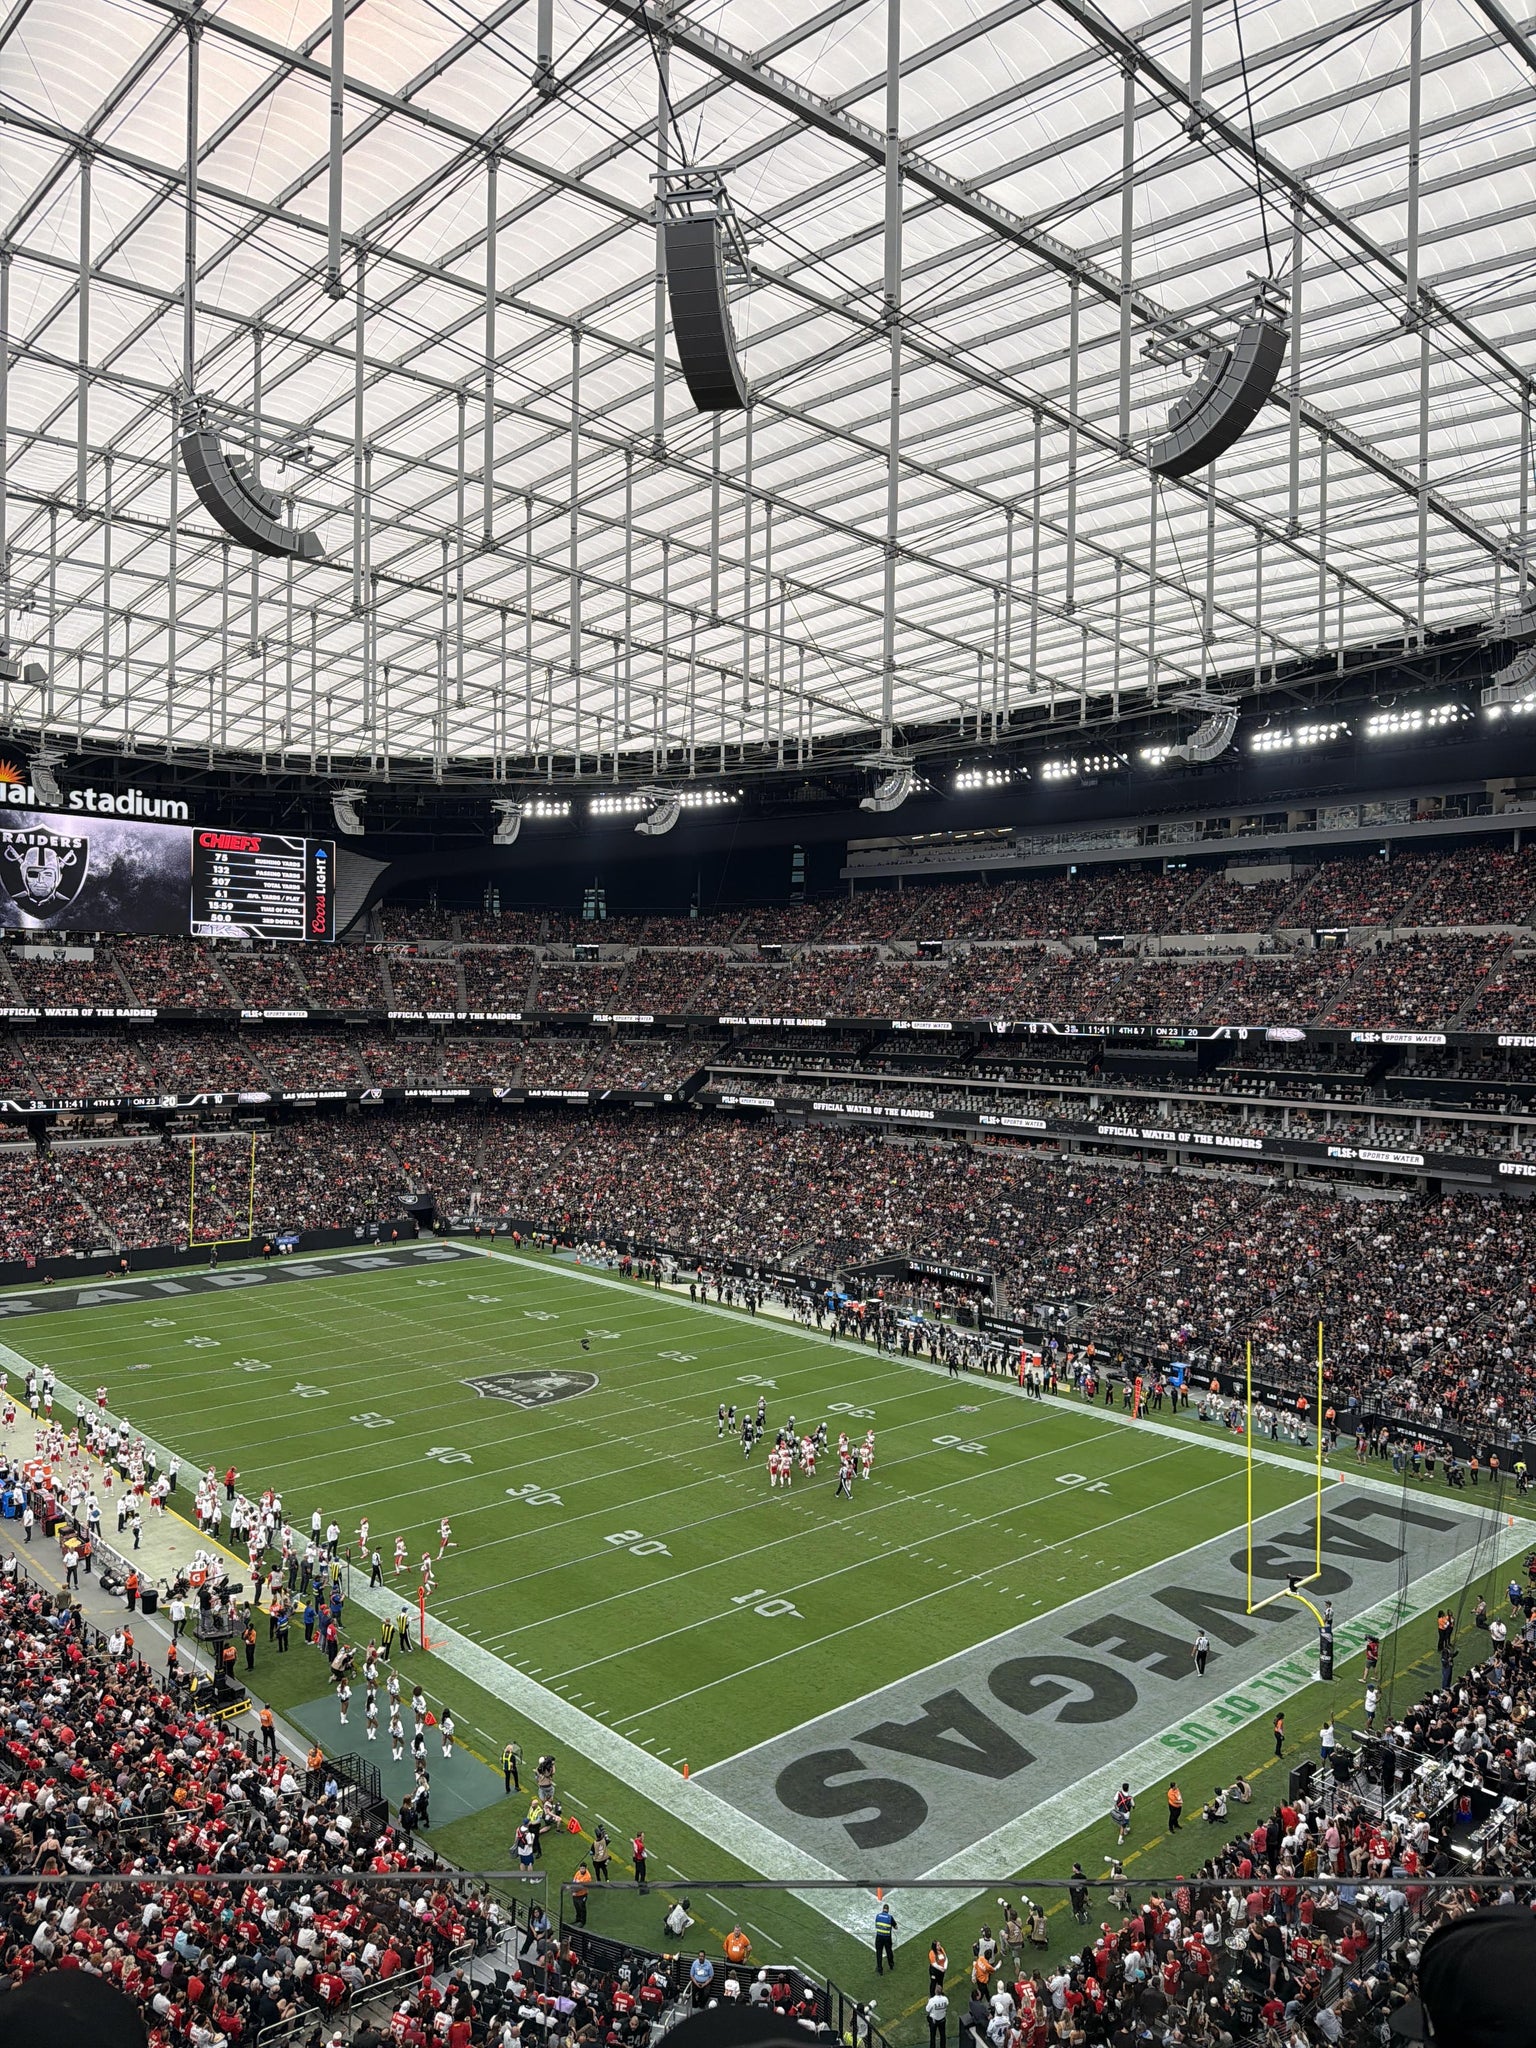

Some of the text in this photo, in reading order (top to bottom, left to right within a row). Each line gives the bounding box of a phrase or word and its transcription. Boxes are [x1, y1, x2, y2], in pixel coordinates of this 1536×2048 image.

[69, 788, 189, 820] stadium
[2, 833, 82, 848] RAIDERS
[199, 832, 261, 852] CHIEFS
[215, 853, 228, 862] 75
[213, 865, 230, 874] 132
[212, 877, 231, 886] 207
[215, 890, 228, 898] 6.1
[312, 858, 327, 934] Coors LIGHT
[208, 901, 234, 911] 15:59
[210, 914, 232, 922] 50.0
[0, 1008, 158, 1017] OFFICIAL WATER OF THE RAIDERS
[719, 1017, 747, 1025] OFFICIAL
[748, 1017, 771, 1025] WATER
[782, 1018, 795, 1026] THE
[1064, 1024, 1070, 1033] 3
[1088, 1026, 1110, 1034] 11:41
[1188, 1028, 1198, 1036] 20
[1238, 1029, 1248, 1039] 10
[30, 1101, 36, 1109] 3
[59, 1100, 83, 1108] 11:41
[162, 1097, 176, 1107] 20
[214, 1096, 223, 1104] 10
[813, 1103, 935, 1119] OFFICIAL WATER OF THE RAIDERS
[1098, 1126, 1263, 1149] OFFICIAL WATER OF THE RAIDERS
[1393, 1155, 1420, 1163] WATER
[909, 1262, 914, 1270] 3
[926, 1265, 942, 1274] 11:41
[949, 1270, 960, 1278] 4TH
[976, 1275, 984, 1283] 20
[0, 1249, 461, 1315] RAIDERS
[290, 1383, 330, 1398] 40
[474, 1381, 536, 1404] RAIDERS
[827, 1402, 876, 1417] 30
[350, 1412, 396, 1428] 50
[932, 1435, 987, 1453] 20
[425, 1447, 472, 1464] 40
[1056, 1473, 1110, 1492] 10
[505, 1484, 561, 1506] 30
[604, 1530, 668, 1556] 20
[1230, 1497, 1461, 1596] LAS
[192, 1573, 201, 1582] G
[730, 1588, 796, 1617] 10
[1250, 1661, 1314, 1695] ALL
[776, 1586, 1303, 1850] VEGAS
[1214, 1694, 1262, 1726] OF
[1159, 1721, 1220, 1754] US
[1374, 1845, 1385, 1856] 15
[1191, 1950, 1203, 1962] 58
[1297, 1947, 1307, 1959] 56
[618, 1968, 631, 1982] 98
